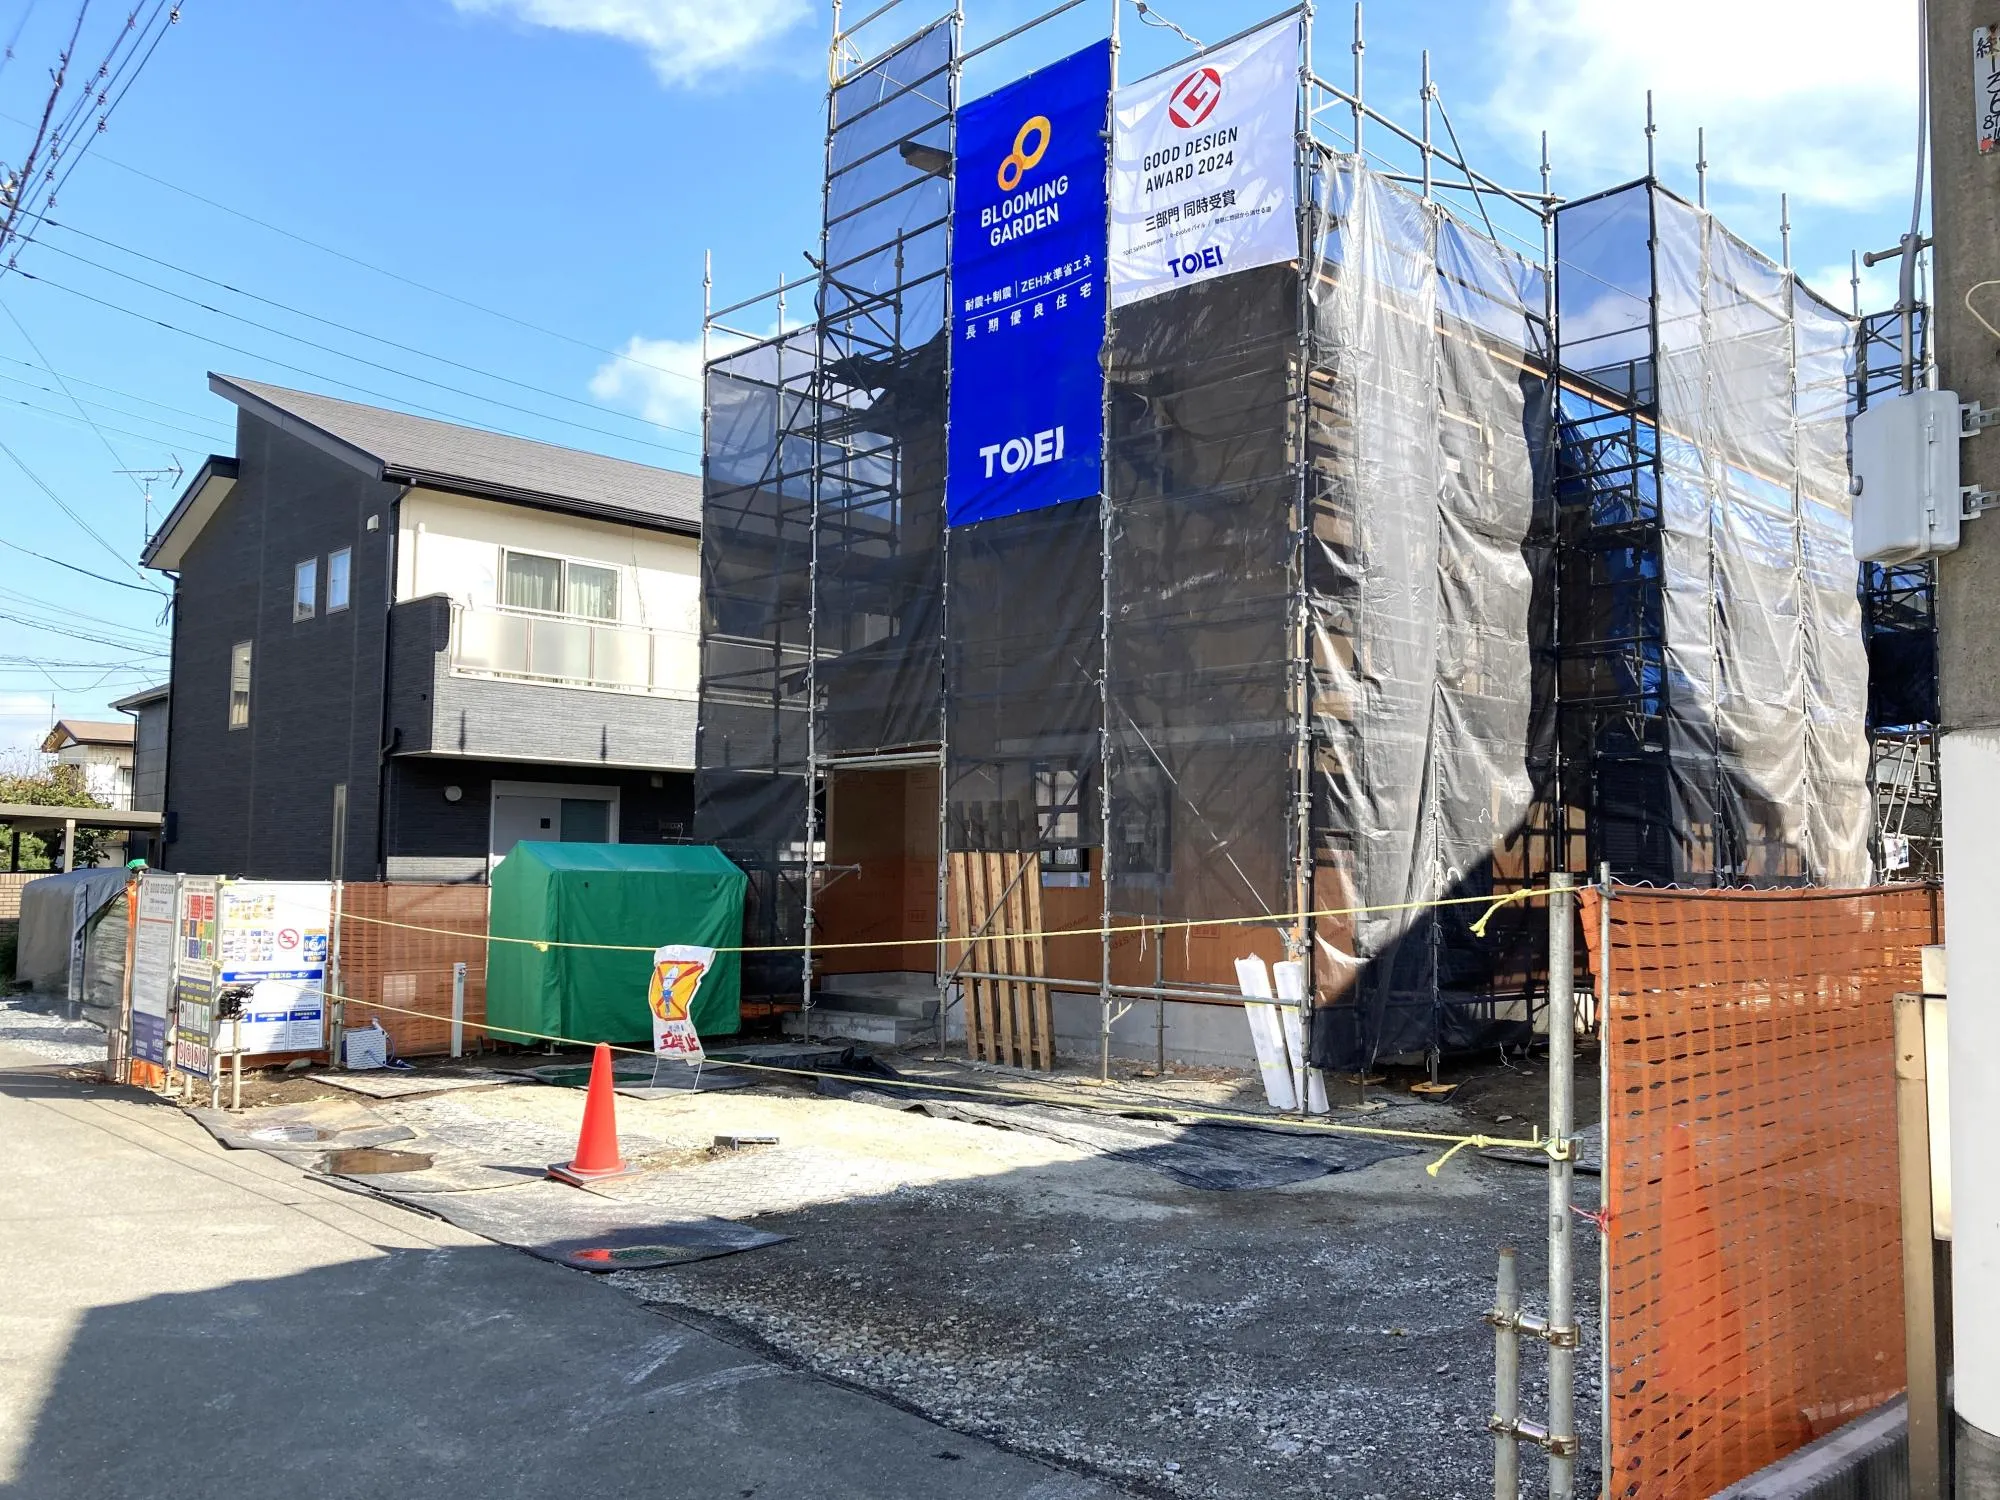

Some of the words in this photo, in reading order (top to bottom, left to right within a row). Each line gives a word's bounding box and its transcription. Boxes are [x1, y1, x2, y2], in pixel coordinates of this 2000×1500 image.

[1144, 146, 1180, 172] GOOD
[1185, 126, 1237, 157] DESIGN
[1146, 163, 1193, 194] AWARD
[1198, 150, 1233, 175] 2024
[981, 175, 1068, 228] BLOOMING
[1145, 206, 1179, 233] 三部門
[1184, 189, 1236, 219] 同時受賞
[990, 202, 1059, 246] GARDEN
[1021, 254, 1092, 293] ZEH水準省エネ
[1168, 245, 1223, 278] TOEI
[965, 282, 1092, 340] 長期優良住宅
[979, 425, 1065, 479] TOEI
